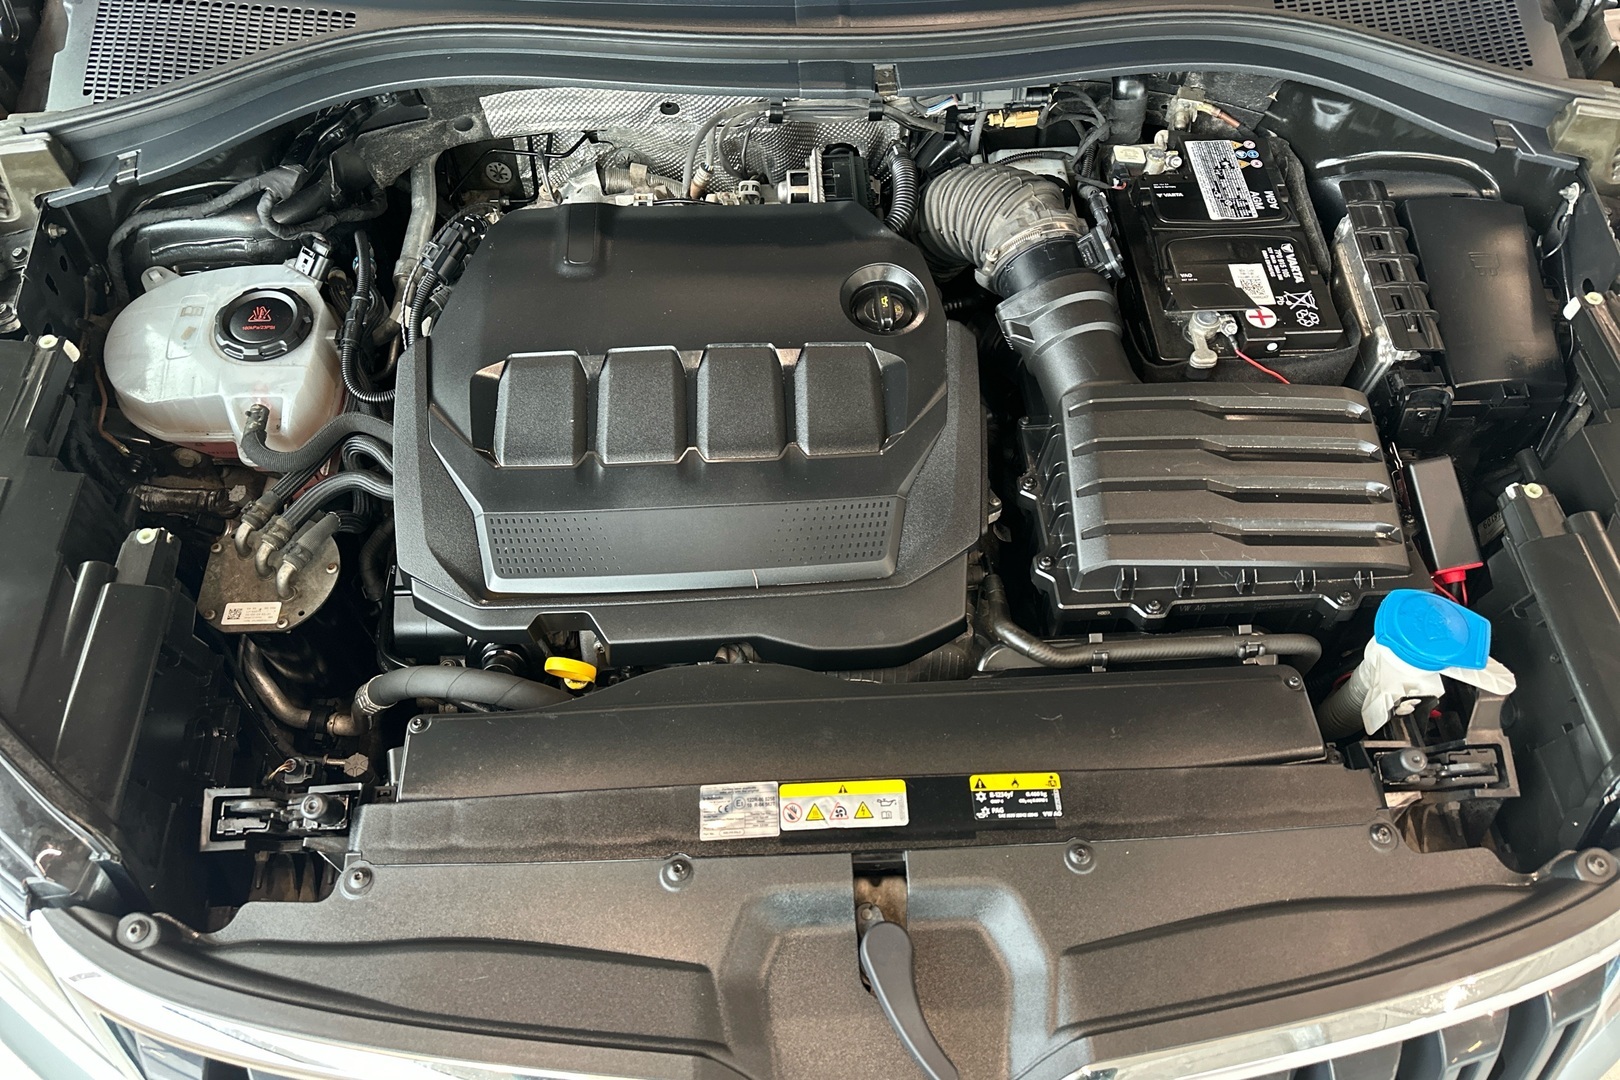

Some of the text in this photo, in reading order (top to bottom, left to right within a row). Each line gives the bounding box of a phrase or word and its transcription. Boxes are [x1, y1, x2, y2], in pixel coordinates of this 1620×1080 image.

[1249, 190, 1265, 210] AGM
[1264, 190, 1280, 210] AGM
[1286, 253, 1305, 283] VARTA
[1275, 295, 1285, 306] Pb
[1194, 604, 1206, 612] AG
